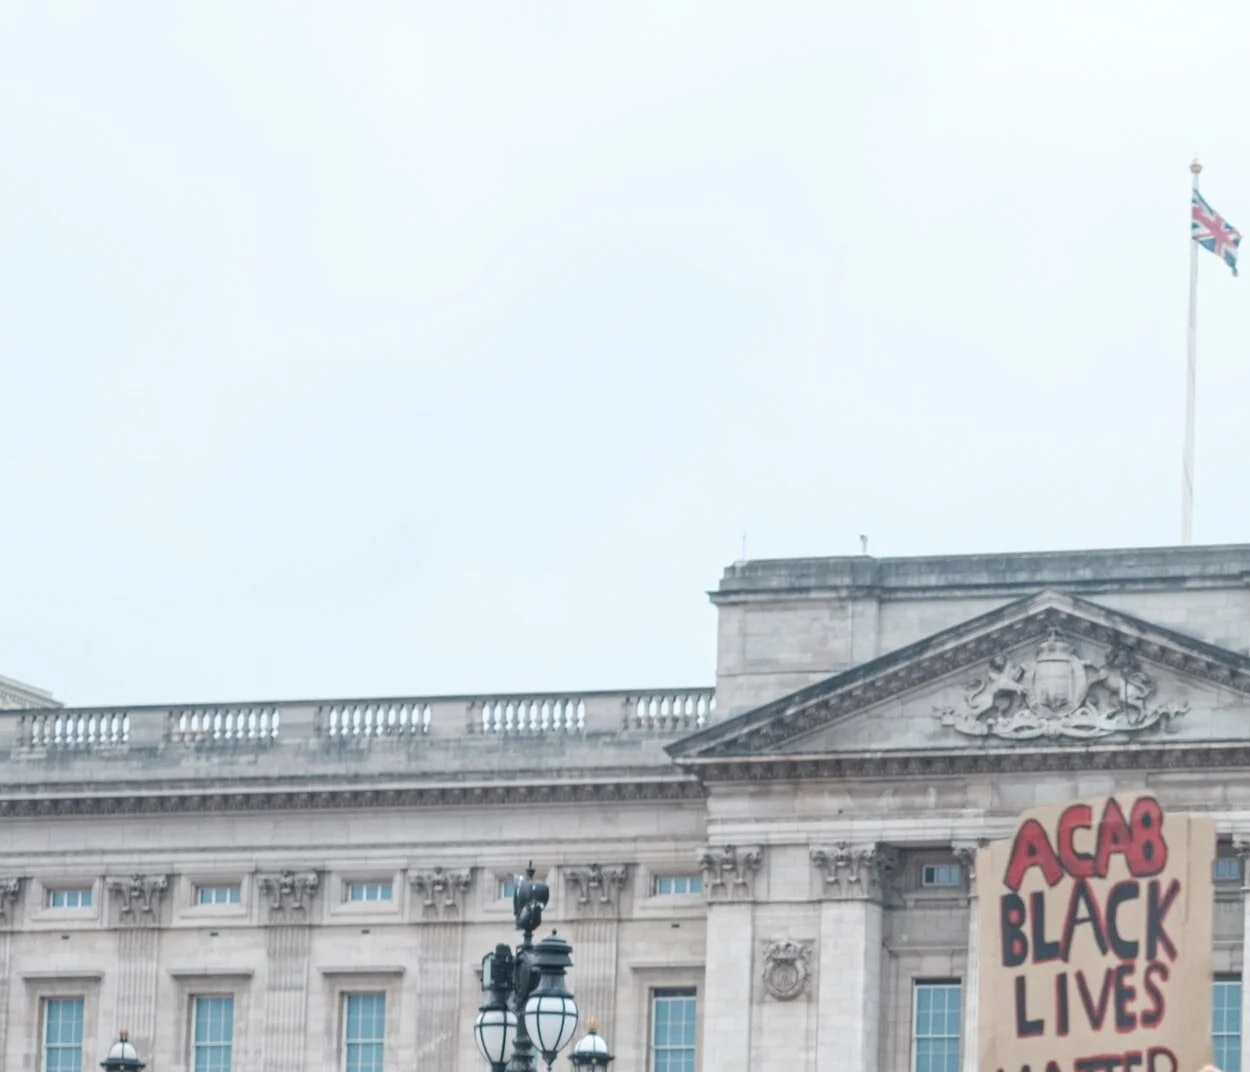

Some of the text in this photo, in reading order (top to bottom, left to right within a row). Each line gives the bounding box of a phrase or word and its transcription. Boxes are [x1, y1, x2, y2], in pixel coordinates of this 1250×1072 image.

[1003, 796, 1168, 894] ACAB
[1000, 877, 1180, 967] BLACK
[1014, 960, 1169, 1038] LIVES
